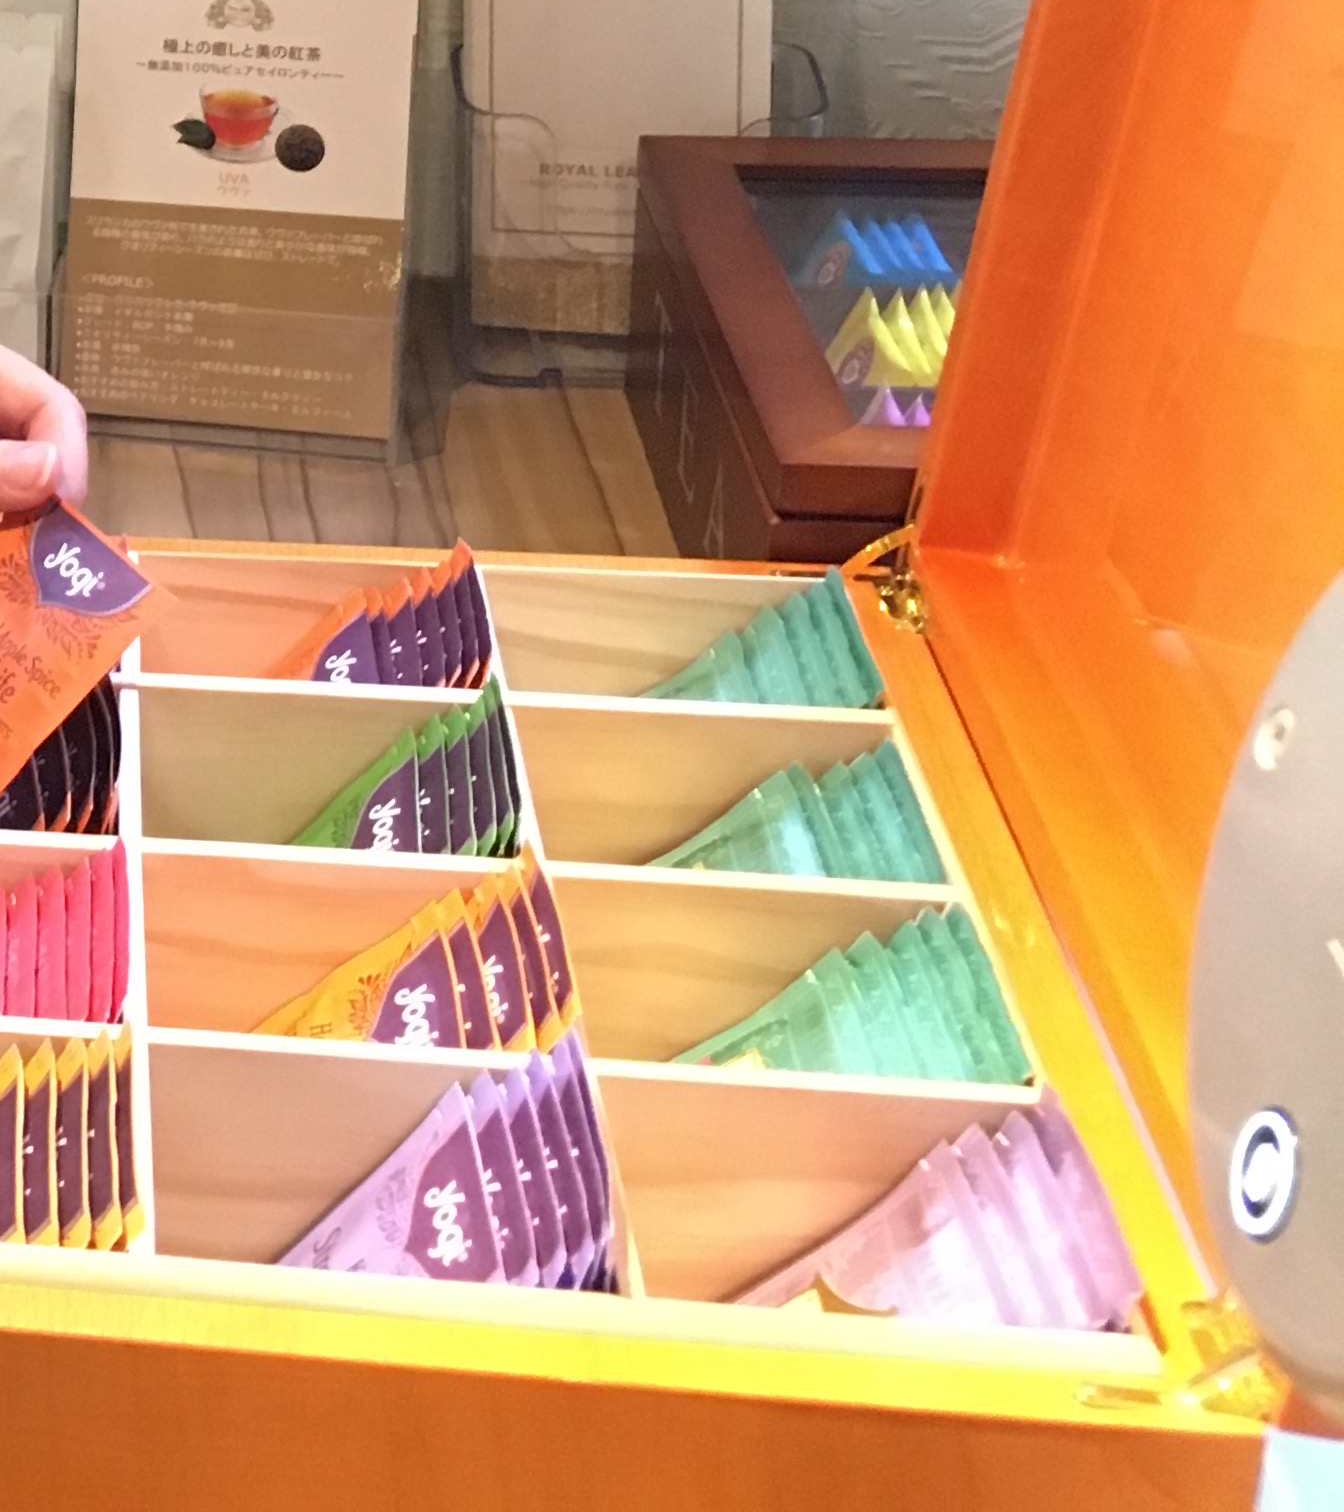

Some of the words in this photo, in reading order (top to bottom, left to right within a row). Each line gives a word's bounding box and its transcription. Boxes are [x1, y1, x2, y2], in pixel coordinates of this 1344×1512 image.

[162, 38, 322, 63] 極上の癒しと美の紅茶
[218, 172, 250, 185] UVA
[539, 161, 597, 177] ROYAL
[604, 164, 638, 178] LEA
[43, 541, 104, 598] yogi
[23, 655, 62, 700] Spice
[394, 983, 440, 1048] yogi
[423, 1179, 473, 1268] yogi
